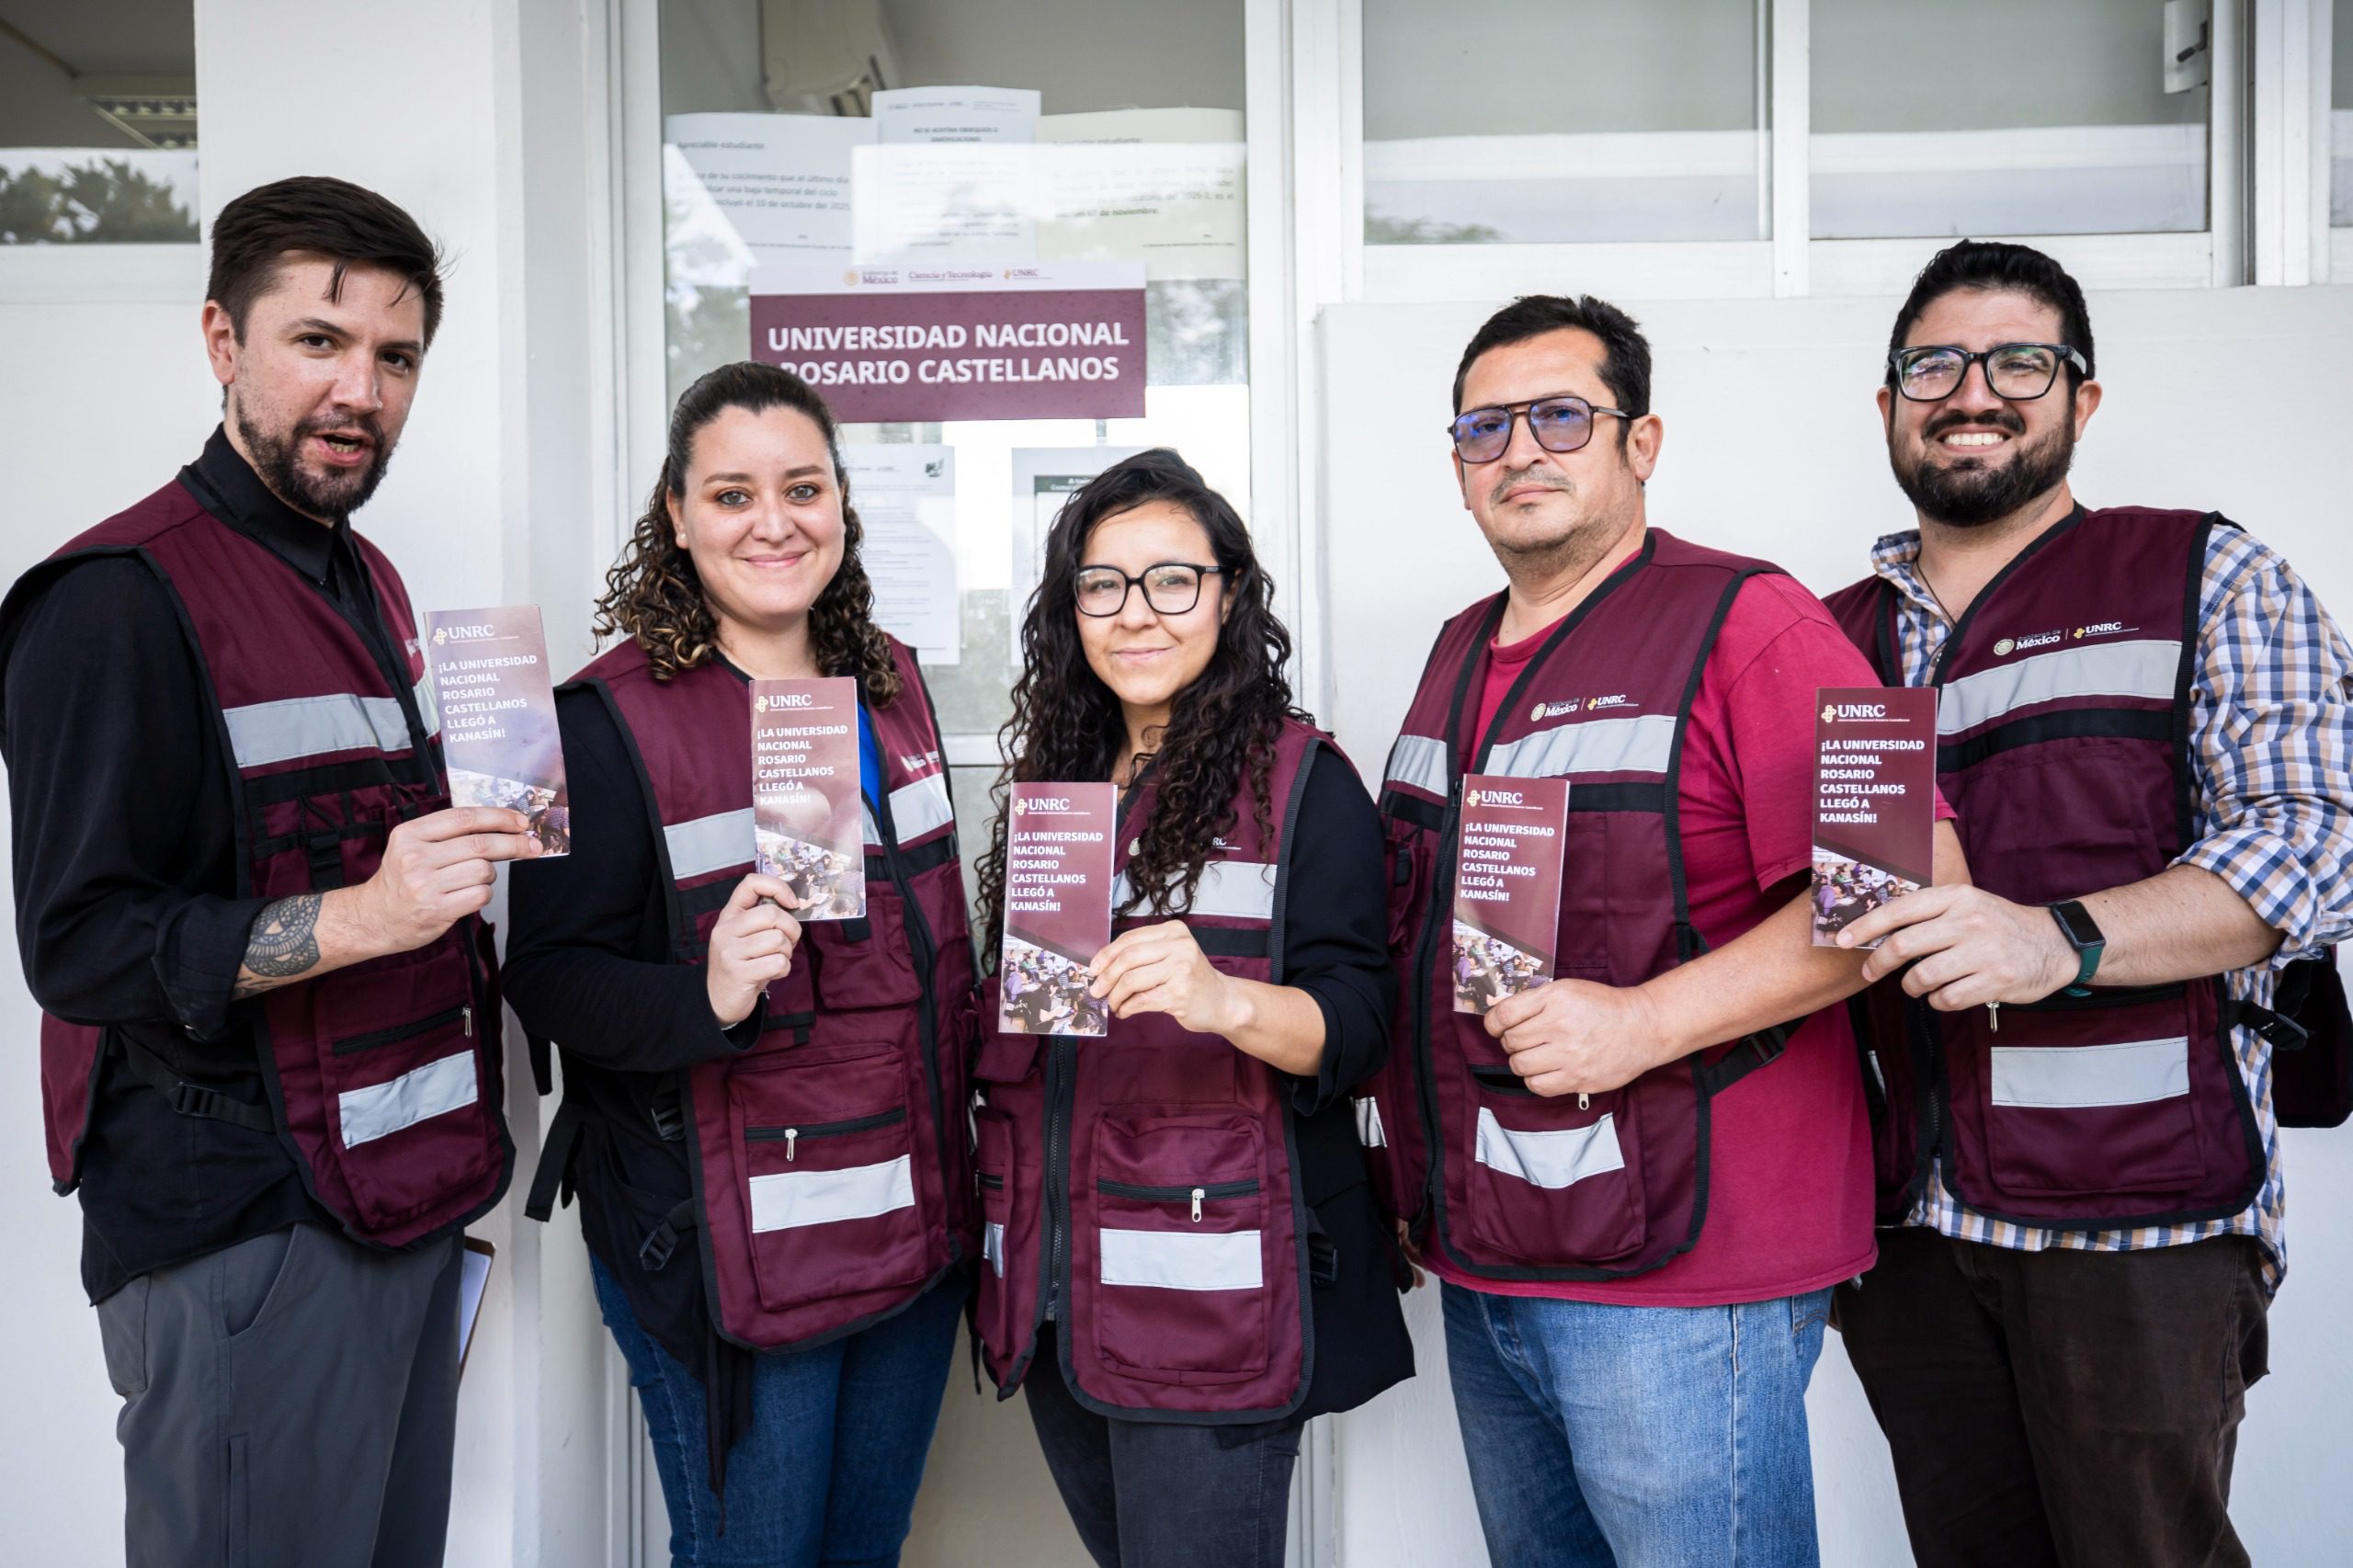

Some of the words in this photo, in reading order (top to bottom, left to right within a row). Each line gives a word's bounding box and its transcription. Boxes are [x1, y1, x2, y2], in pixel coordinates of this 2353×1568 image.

[767, 324, 967, 351] UNIVERSIDAD
[975, 322, 1130, 347] NACIONAL
[917, 357, 1120, 383] CASTELLANOS
[448, 624, 494, 640] UNRC
[2086, 621, 2121, 634] UNRC
[2016, 635, 2061, 650] México
[438, 662, 457, 674] ¡LA
[460, 654, 538, 669] UNIVERSIDAD
[440, 672, 500, 687] NACIONAL
[442, 687, 495, 700] ROSARIO
[1597, 694, 1626, 705] UNRC
[445, 699, 528, 714] CASTELLANOS
[769, 694, 812, 707] UNRC
[1544, 704, 1578, 717] México
[1837, 704, 1886, 718] UNRC
[447, 714, 485, 729] LLEGÓ
[488, 715, 496, 725] A
[449, 728, 506, 744] KANASÍN!
[757, 727, 775, 740] ¡LA
[777, 724, 847, 737] UNIVERSIDAD
[757, 740, 813, 752] NACIONAL
[1821, 740, 1841, 752] ¡LA
[1843, 740, 1925, 750] UNIVERSIDAD
[758, 754, 806, 765] ROSARIO
[1820, 755, 1882, 765] NACIONAL
[758, 766, 835, 778] CASTELLANOS
[1820, 769, 1875, 779] ROSARIO
[759, 779, 794, 792] LLEGÓ
[796, 781, 804, 790] A
[1820, 783, 1906, 794] CASTELLANOS
[760, 793, 812, 806] KANASÍN!
[1481, 790, 1523, 804] UNRC
[1820, 796, 1859, 809] LLEGÓ
[1861, 799, 1870, 809] A
[1028, 798, 1070, 811] UNRC
[1820, 811, 1877, 824] KANASÍN!
[1465, 823, 1482, 834] ¡LA
[1484, 823, 1555, 836] UNIVERSIDAD
[1014, 832, 1030, 843] ¡LA
[1032, 832, 1103, 842] UNIVERSIDAD
[1464, 835, 1518, 847] NACIONAL
[1013, 846, 1066, 856] NACIONAL
[1463, 849, 1510, 861] ROSARIO
[1013, 859, 1060, 869] ROSARIO
[1461, 862, 1536, 876] CASTELLANOS
[1012, 873, 1086, 884] CASTELLANOS
[1461, 875, 1495, 887] LLEGÓ
[1496, 878, 1504, 888] A
[1011, 885, 1045, 897] LLEGÓ
[1047, 888, 1054, 897] A
[1461, 889, 1510, 902] KANASÍN!
[1011, 899, 1061, 912] KANASÍN!
